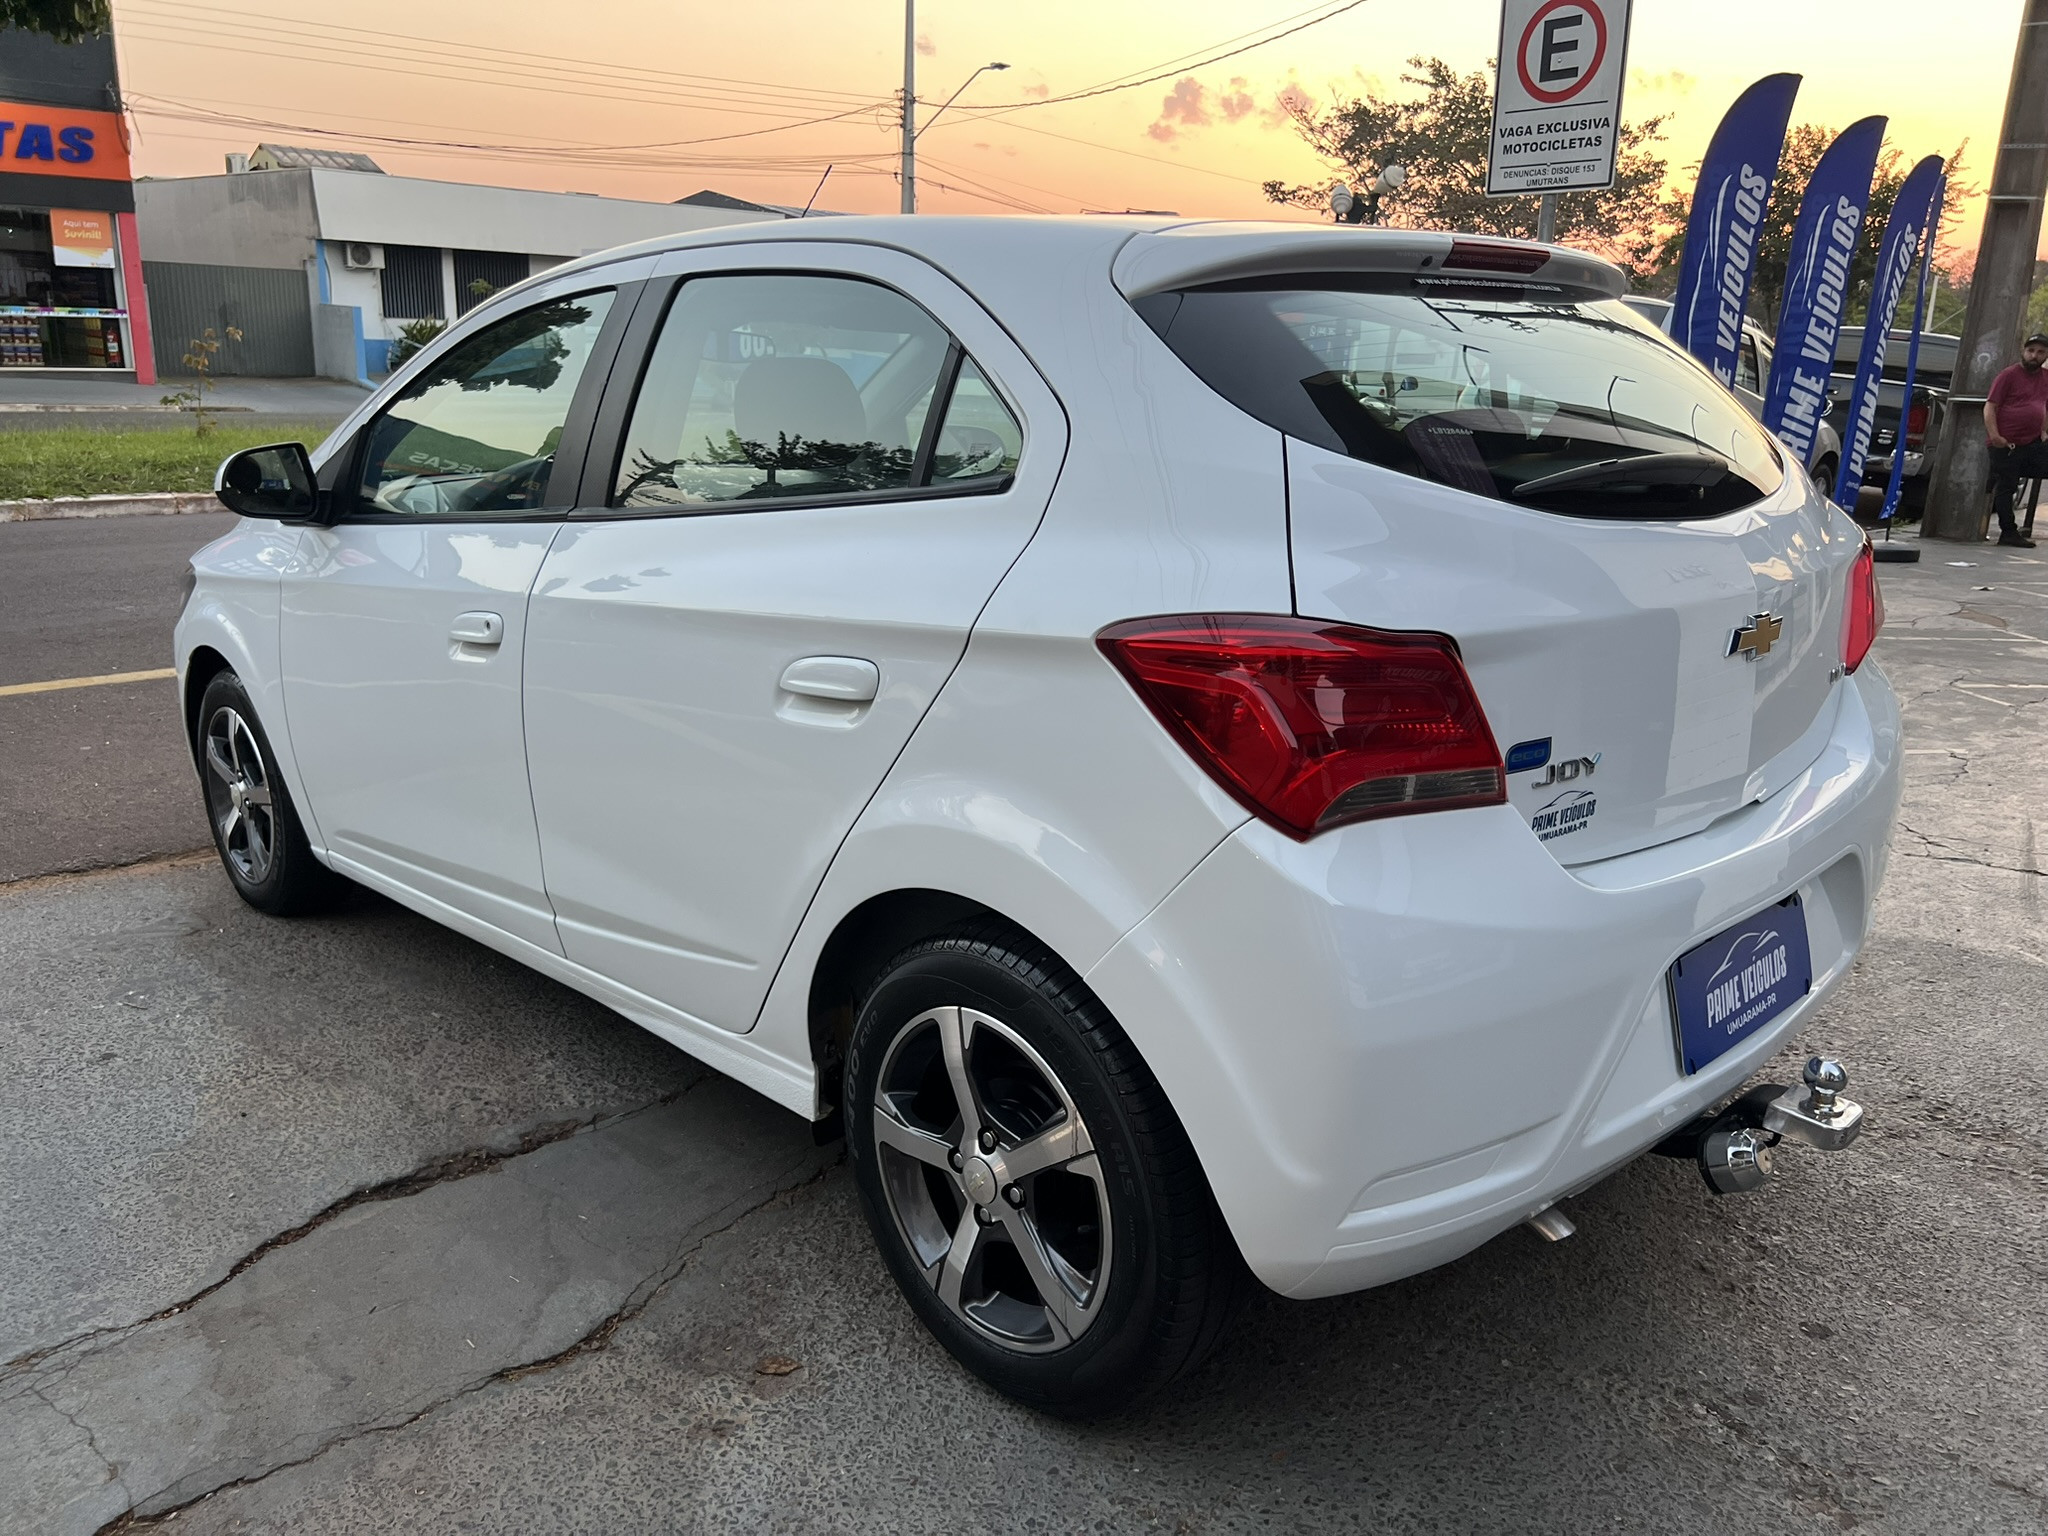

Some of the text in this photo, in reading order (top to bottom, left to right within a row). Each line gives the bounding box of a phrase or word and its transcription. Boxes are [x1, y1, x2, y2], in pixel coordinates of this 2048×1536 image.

[1539, 14, 1583, 83] E
[1499, 117, 1611, 139] VAGA EXCLUSIVA
[1502, 135, 1603, 156] MOTOCICLETAS
[1503, 164, 1596, 179] DENUNCIAS: DISQUE 153
[1526, 176, 1569, 187] UMUTRANS
[63, 219, 99, 229] Aqui tem
[1715, 162, 1767, 354] VEÍCULOS
[1777, 195, 1861, 462] RIME VEÍCULOS
[1531, 752, 1602, 789] JOY
[1531, 799, 1597, 833] PRIME VEÍCULOS
[1538, 820, 1588, 842] UMUARAMA-PR
[1706, 944, 1788, 1029] PRIME VEÍCULOS
[1726, 992, 1777, 1036] UMUARAMA-PR
